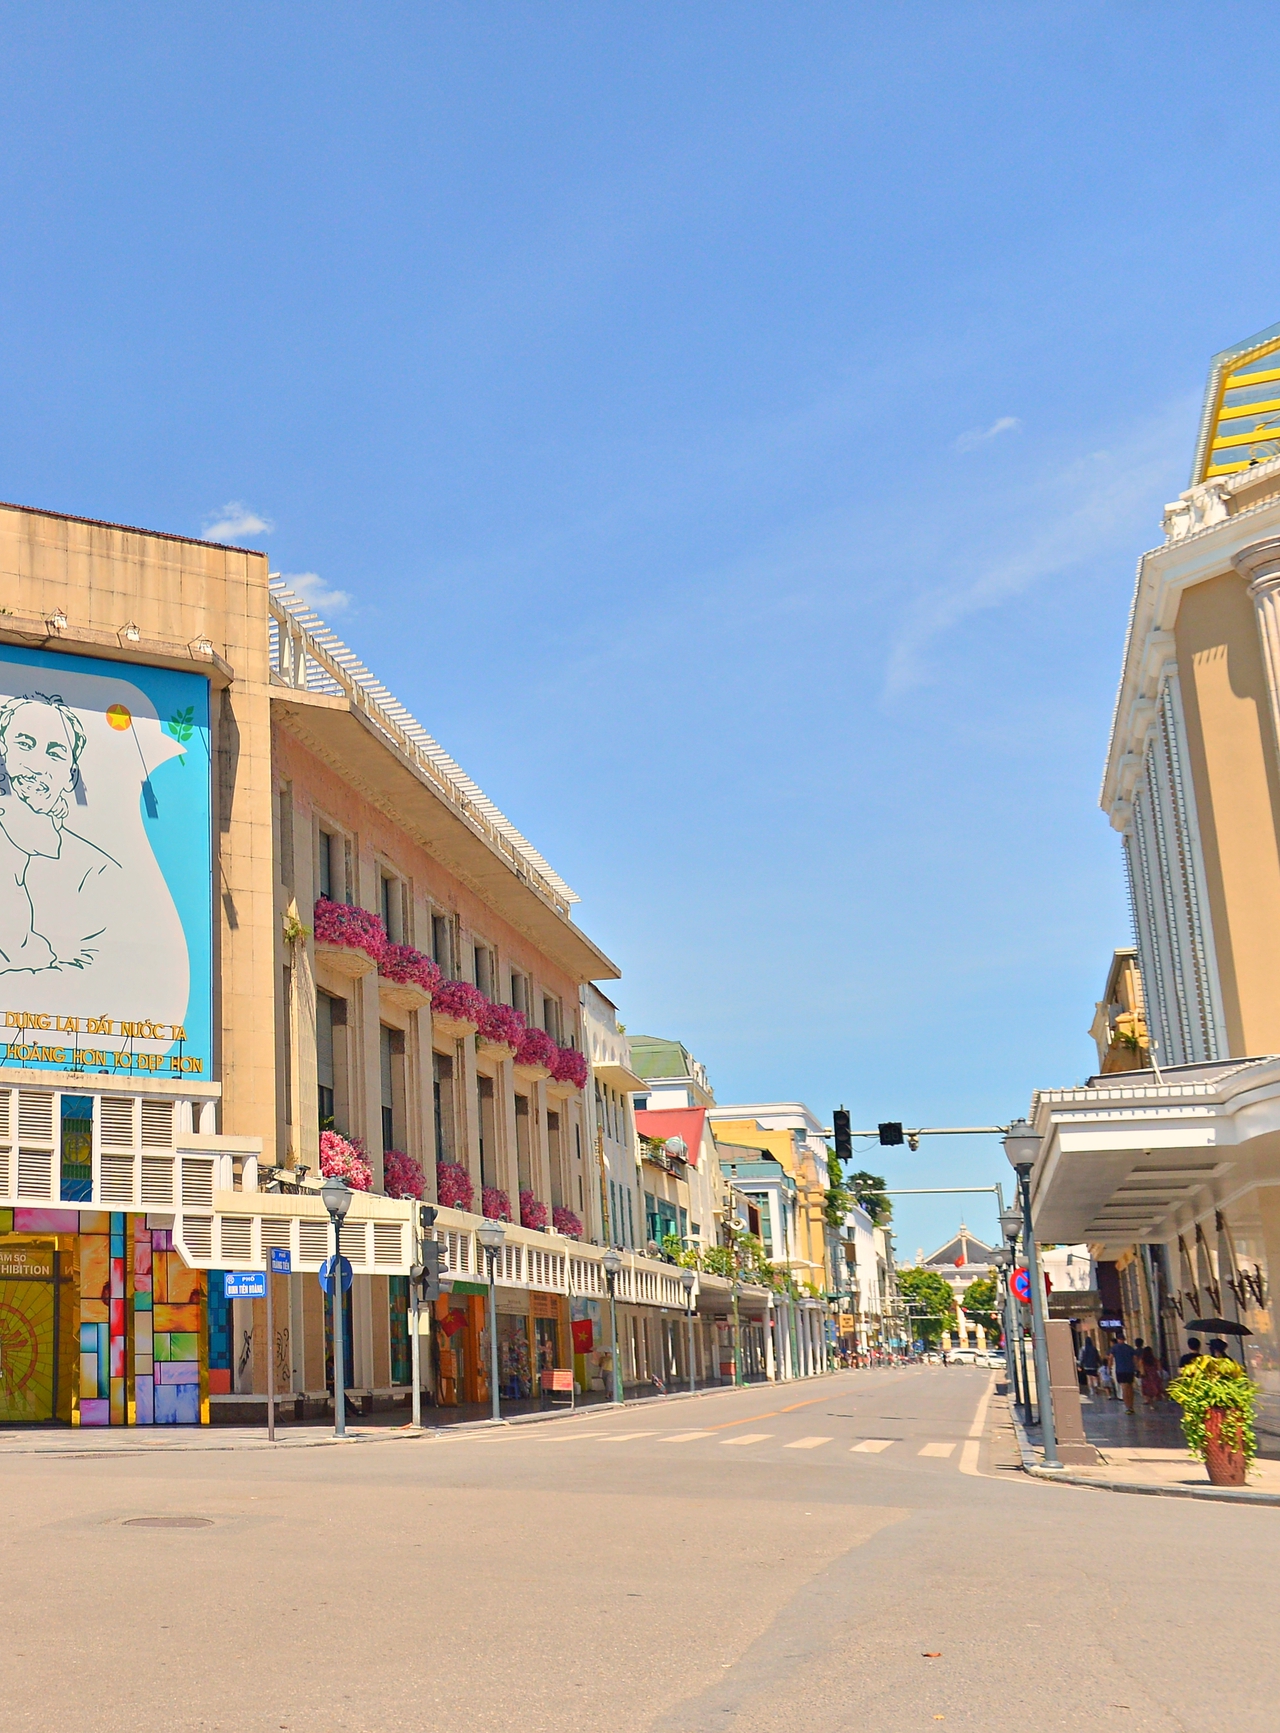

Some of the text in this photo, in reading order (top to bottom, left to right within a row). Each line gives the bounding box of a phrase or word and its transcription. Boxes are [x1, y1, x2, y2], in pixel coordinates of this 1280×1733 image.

[5, 1009, 52, 1031] DỰNG
[56, 1014, 80, 1034] LẠI
[87, 1013, 114, 1035] ĐẤT
[121, 1018, 165, 1040] NƯỚC
[171, 1024, 188, 1041] TA
[6, 1040, 66, 1063] HOÀNG
[73, 1047, 106, 1066] HƠN
[113, 1051, 132, 1068] TO
[138, 1053, 164, 1073] ĐẸP
[170, 1055, 204, 1073] HƠN
